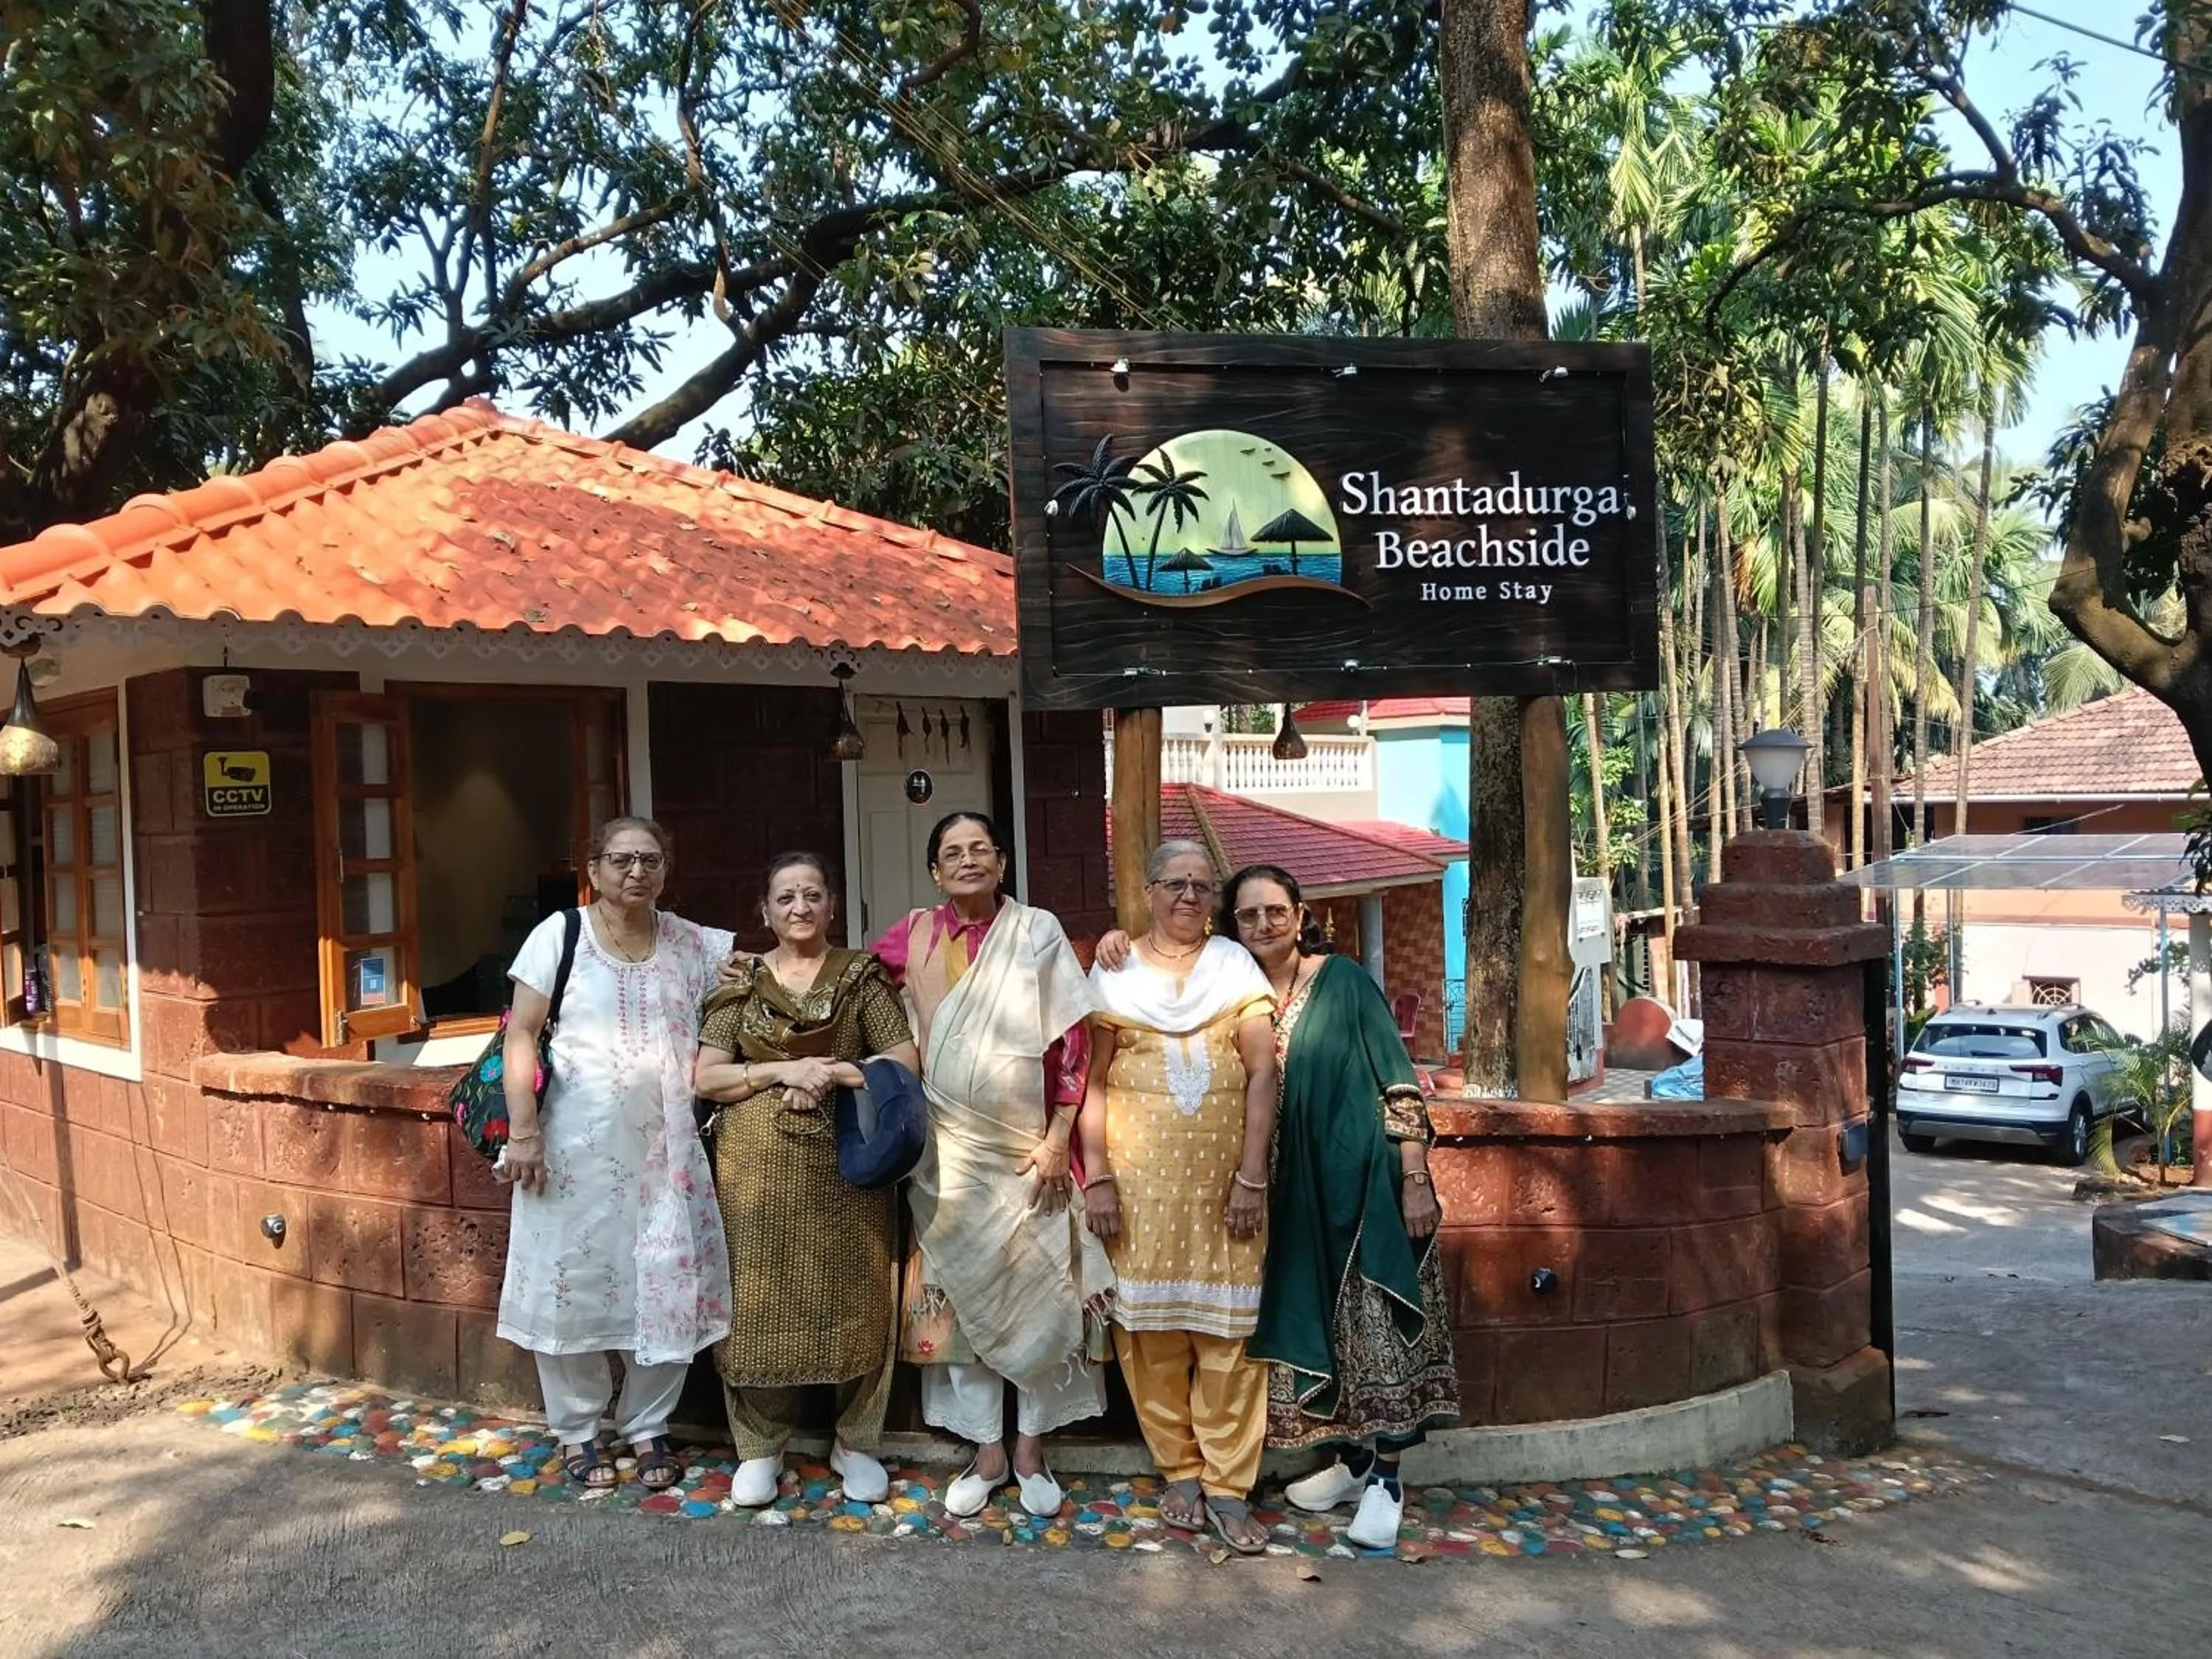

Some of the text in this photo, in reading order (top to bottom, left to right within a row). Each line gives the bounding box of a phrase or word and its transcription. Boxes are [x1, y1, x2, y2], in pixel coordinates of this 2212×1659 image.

[1341, 470, 1621, 527] Shantadurga
[1374, 523, 1590, 568] Beachside
[1421, 581, 1553, 605] Home Stay
[212, 788, 264, 803] CCTV
